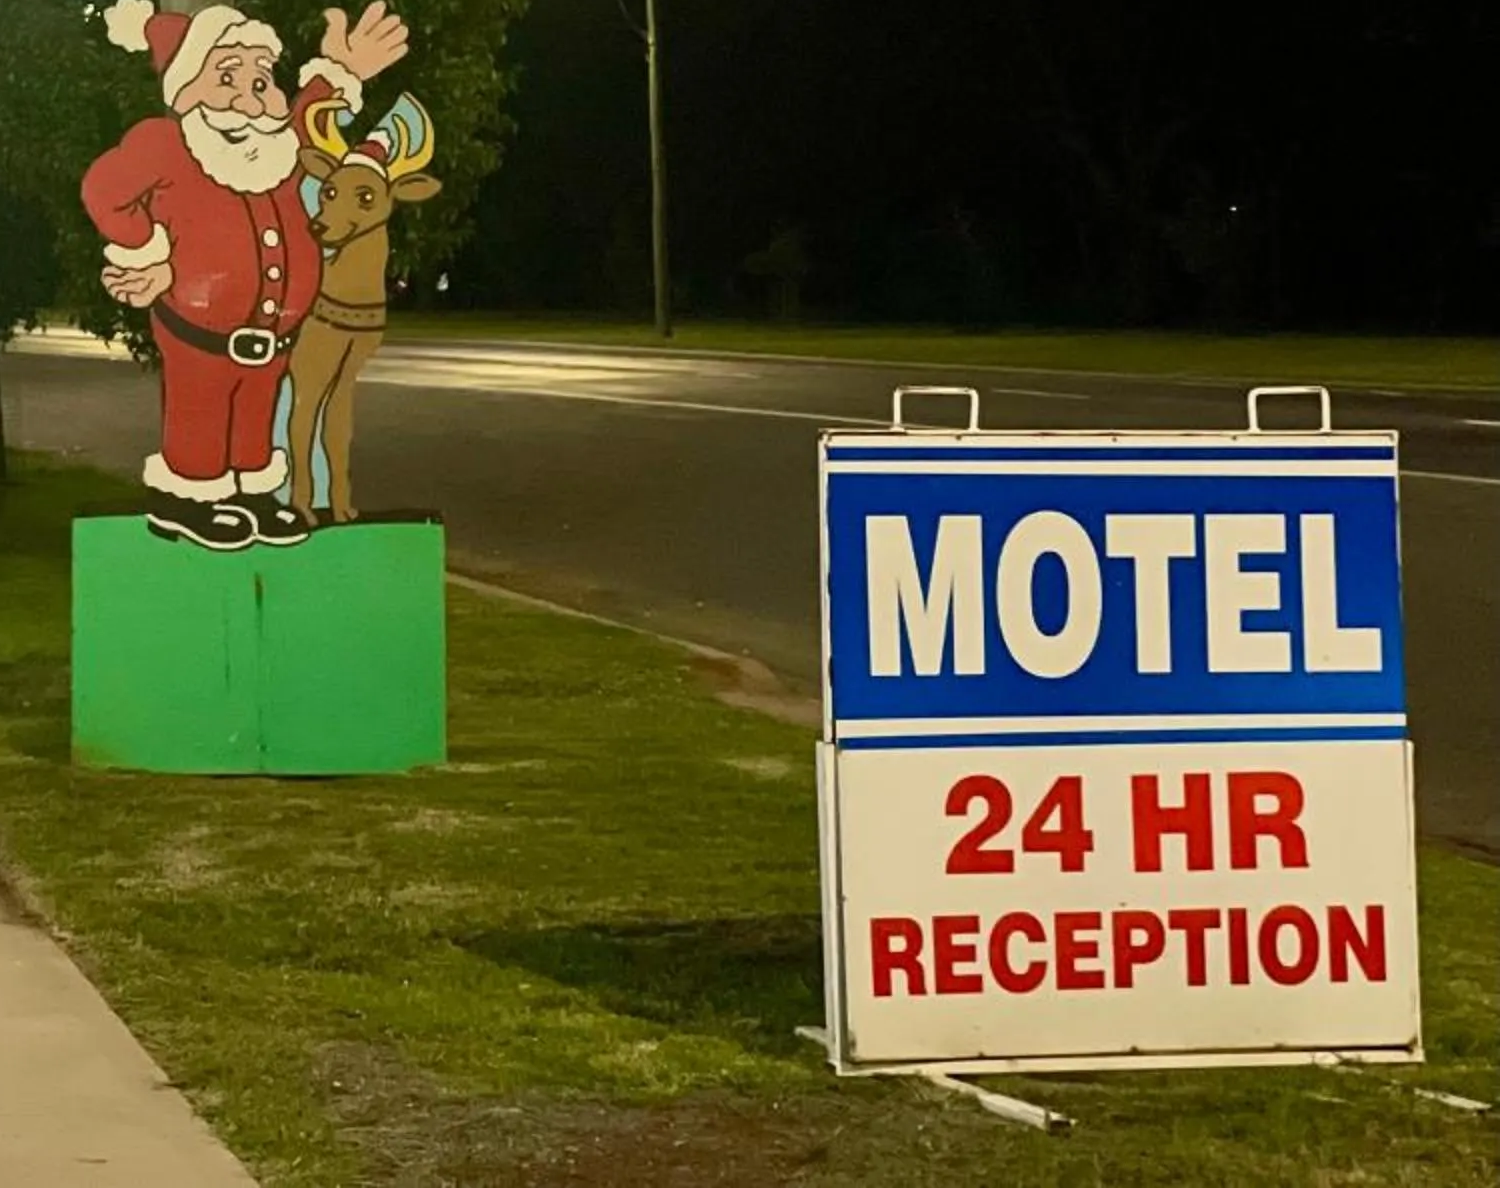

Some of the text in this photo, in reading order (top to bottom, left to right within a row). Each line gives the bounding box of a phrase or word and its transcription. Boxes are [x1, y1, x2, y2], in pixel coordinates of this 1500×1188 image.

[865, 511, 1383, 678] MOTEL
[944, 772, 1310, 875] 24 HR
[870, 905, 1388, 997] RECEPTION
